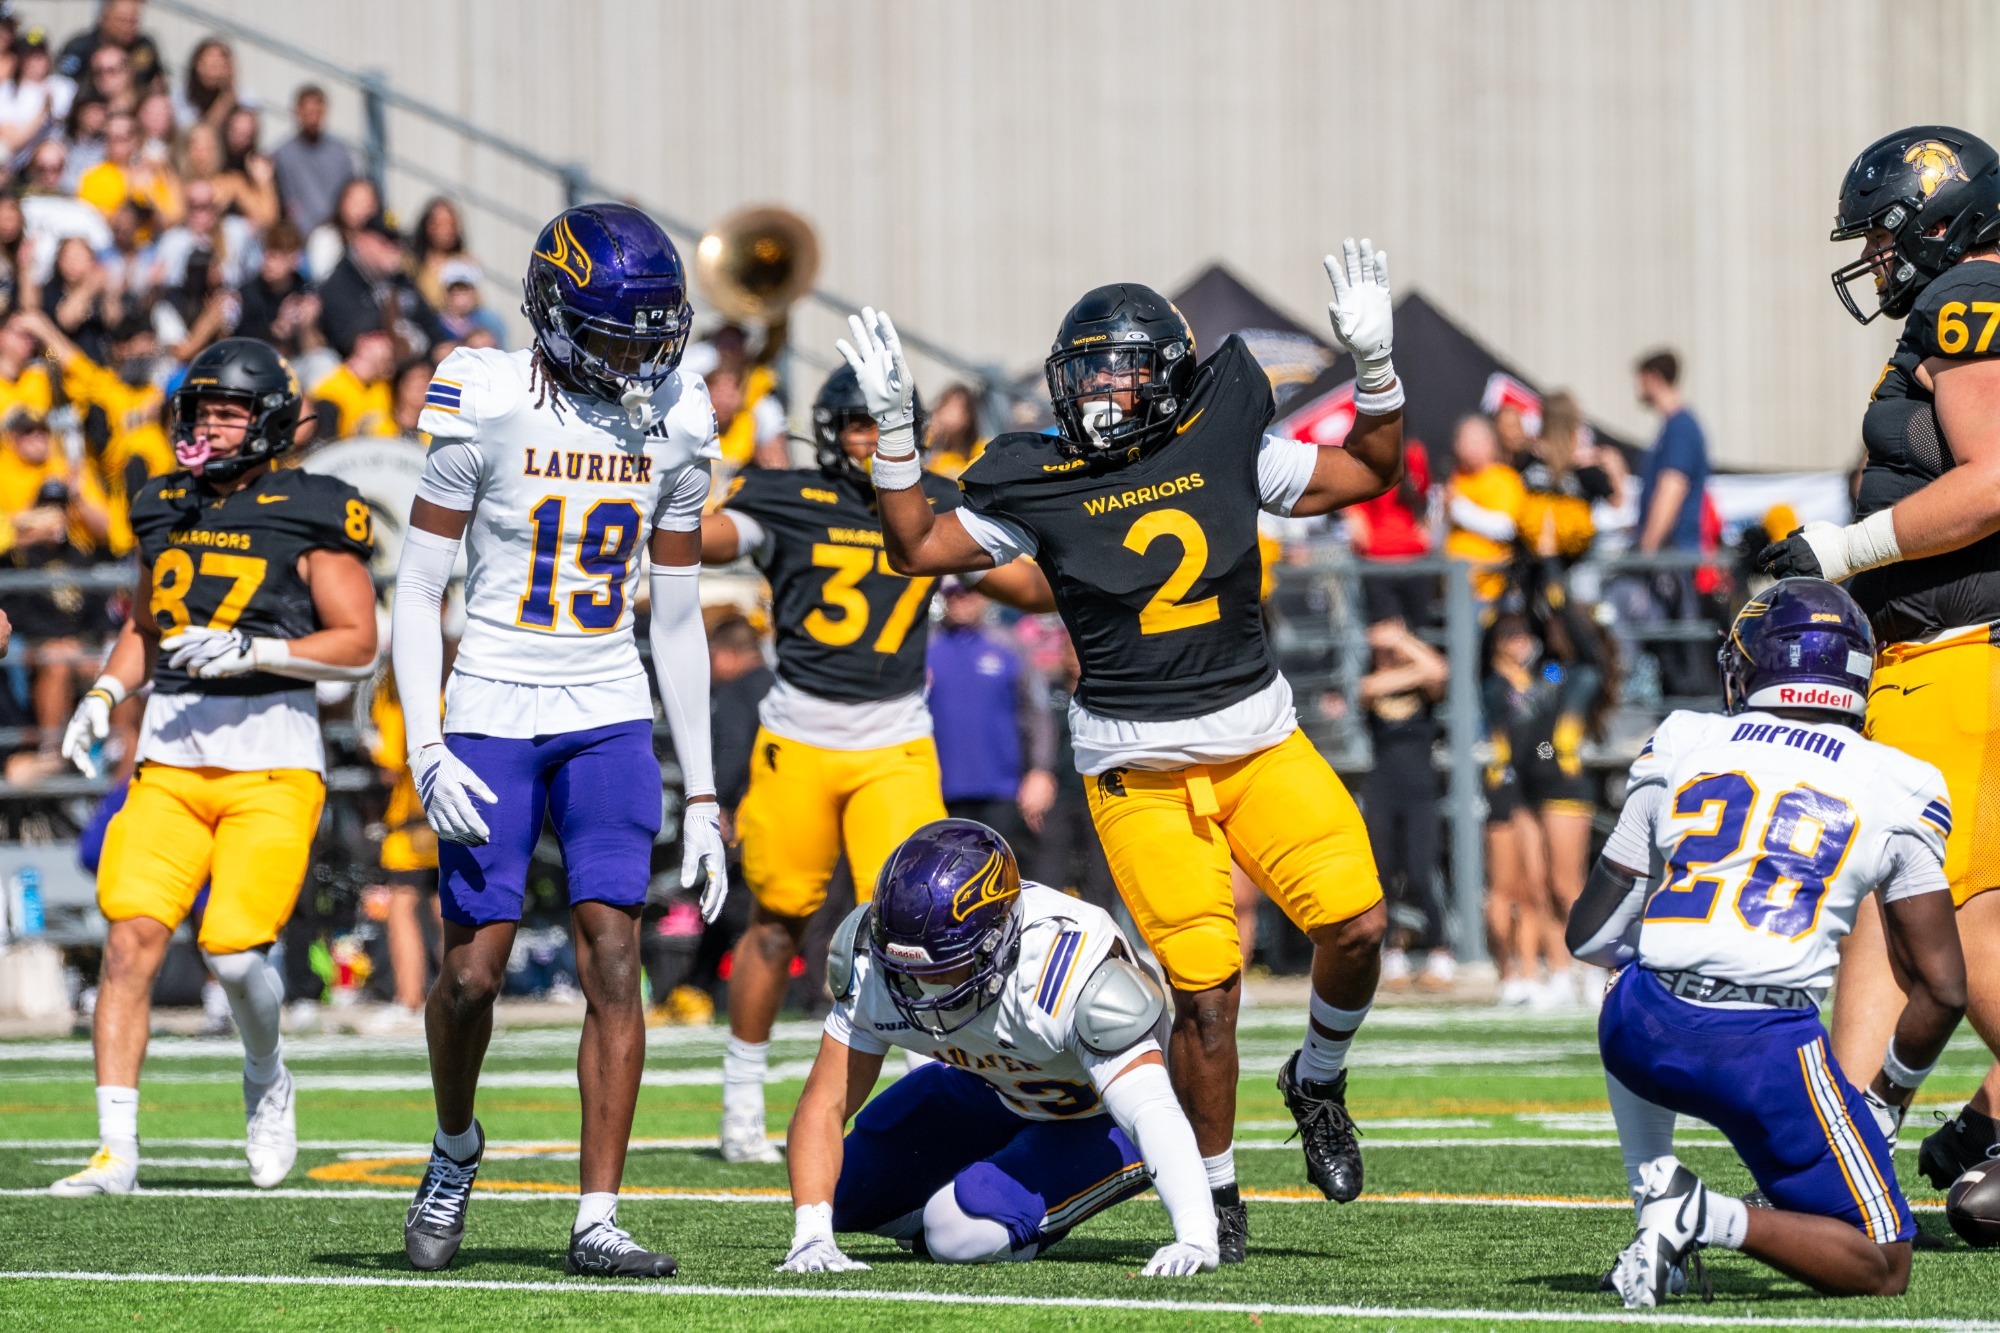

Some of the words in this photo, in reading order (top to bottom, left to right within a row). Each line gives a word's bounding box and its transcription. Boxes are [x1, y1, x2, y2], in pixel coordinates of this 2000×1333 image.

[651, 310, 663, 319] F7
[1937, 301, 2000, 355] 67
[1073, 334, 1107, 345] WATERLOO
[524, 448, 652, 484] LAURIER
[1083, 473, 1205, 516] WARRIORS
[168, 529, 251, 550] WARRIORS
[515, 494, 643, 633] 19
[1122, 508, 1221, 636] 2
[150, 548, 268, 641] 87
[803, 543, 936, 654] 37
[1780, 688, 1853, 709] Riddell
[1730, 722, 1846, 763] DAPAAH
[1643, 770, 1861, 944] 28
